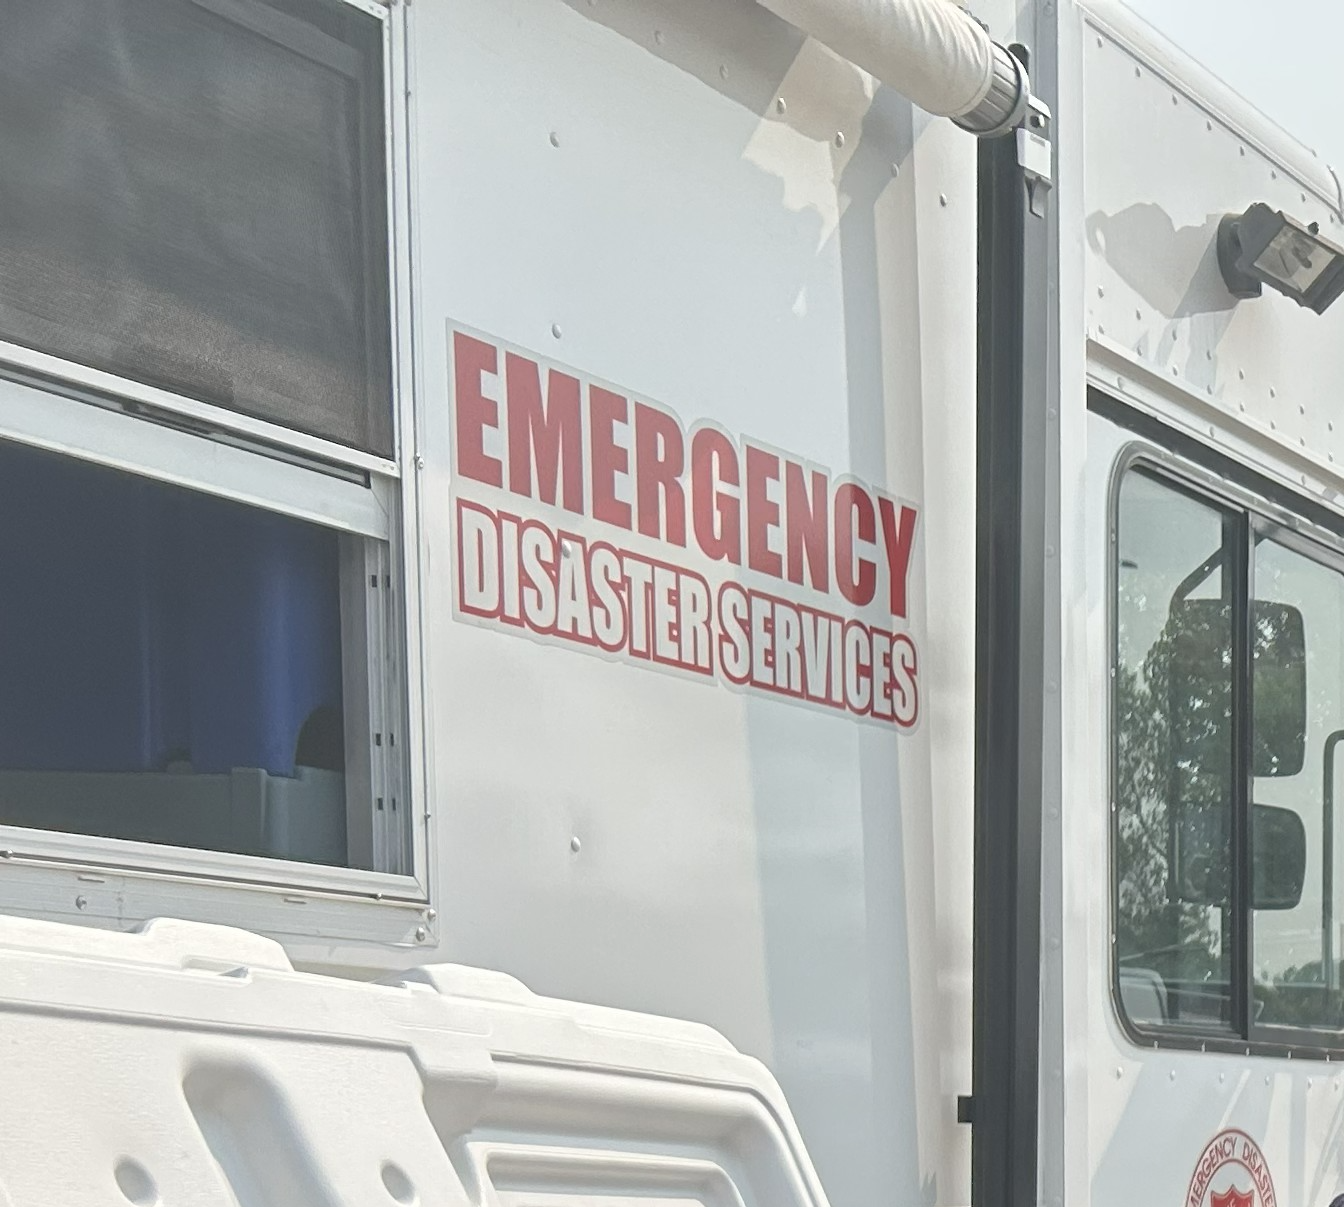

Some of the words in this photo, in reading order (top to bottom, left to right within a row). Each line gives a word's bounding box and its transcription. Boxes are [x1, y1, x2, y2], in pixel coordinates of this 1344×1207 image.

[453, 330, 917, 619] EMERGENCY
[456, 497, 714, 676] DISASTER
[717, 581, 918, 728] SERVICES
